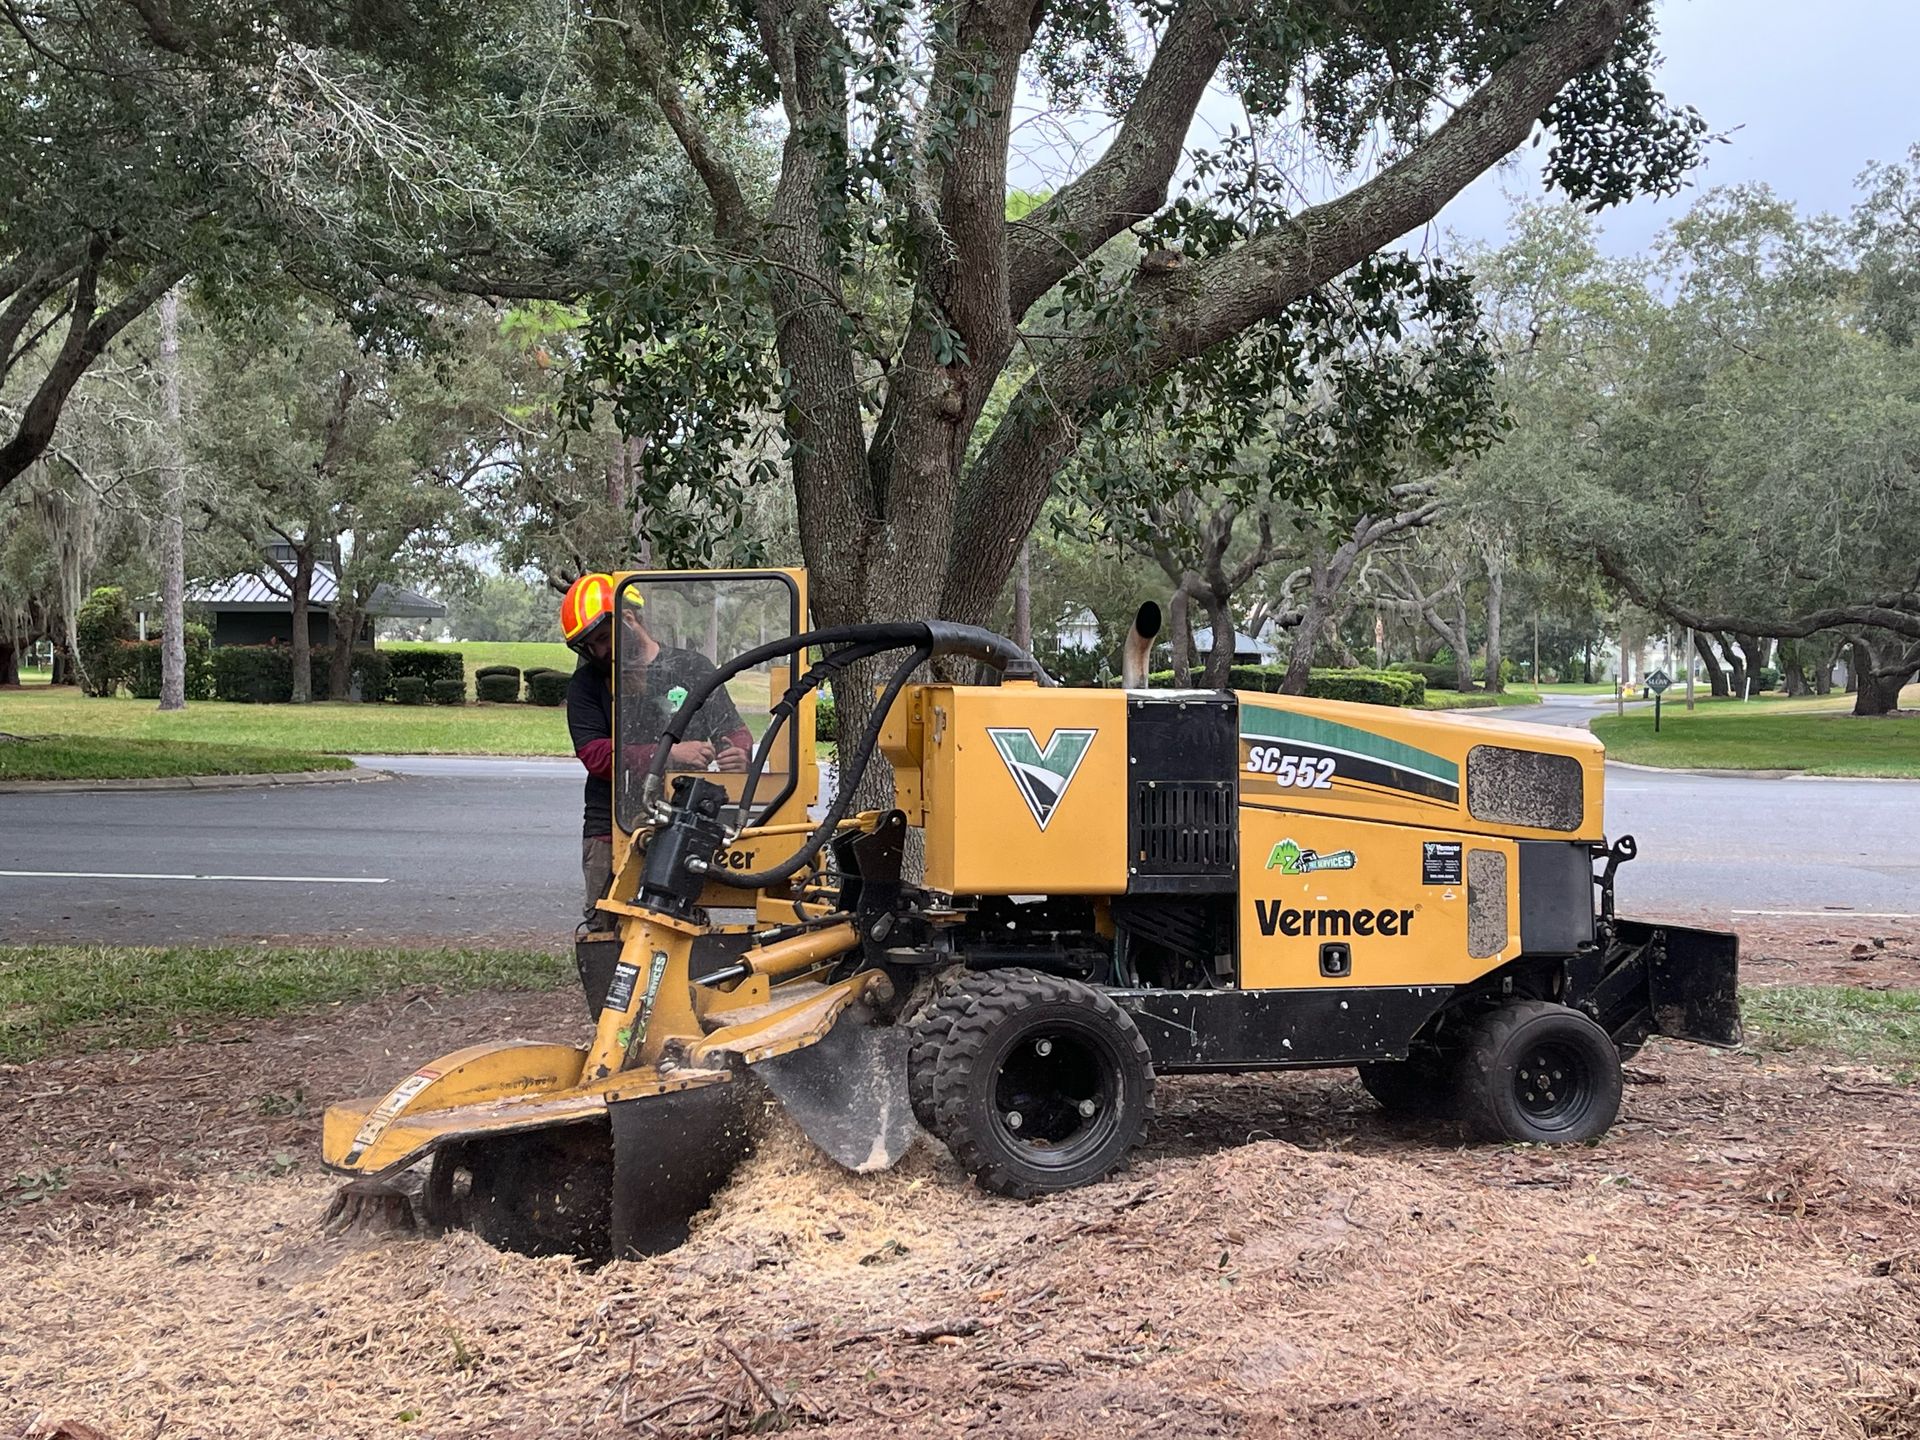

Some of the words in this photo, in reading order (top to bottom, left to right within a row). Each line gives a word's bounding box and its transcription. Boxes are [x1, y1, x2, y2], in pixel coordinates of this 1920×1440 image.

[1246, 746, 1280, 773] SC
[1277, 755, 1336, 789] 552
[714, 850, 755, 870] eer
[1255, 900, 1414, 936] Vermeer
